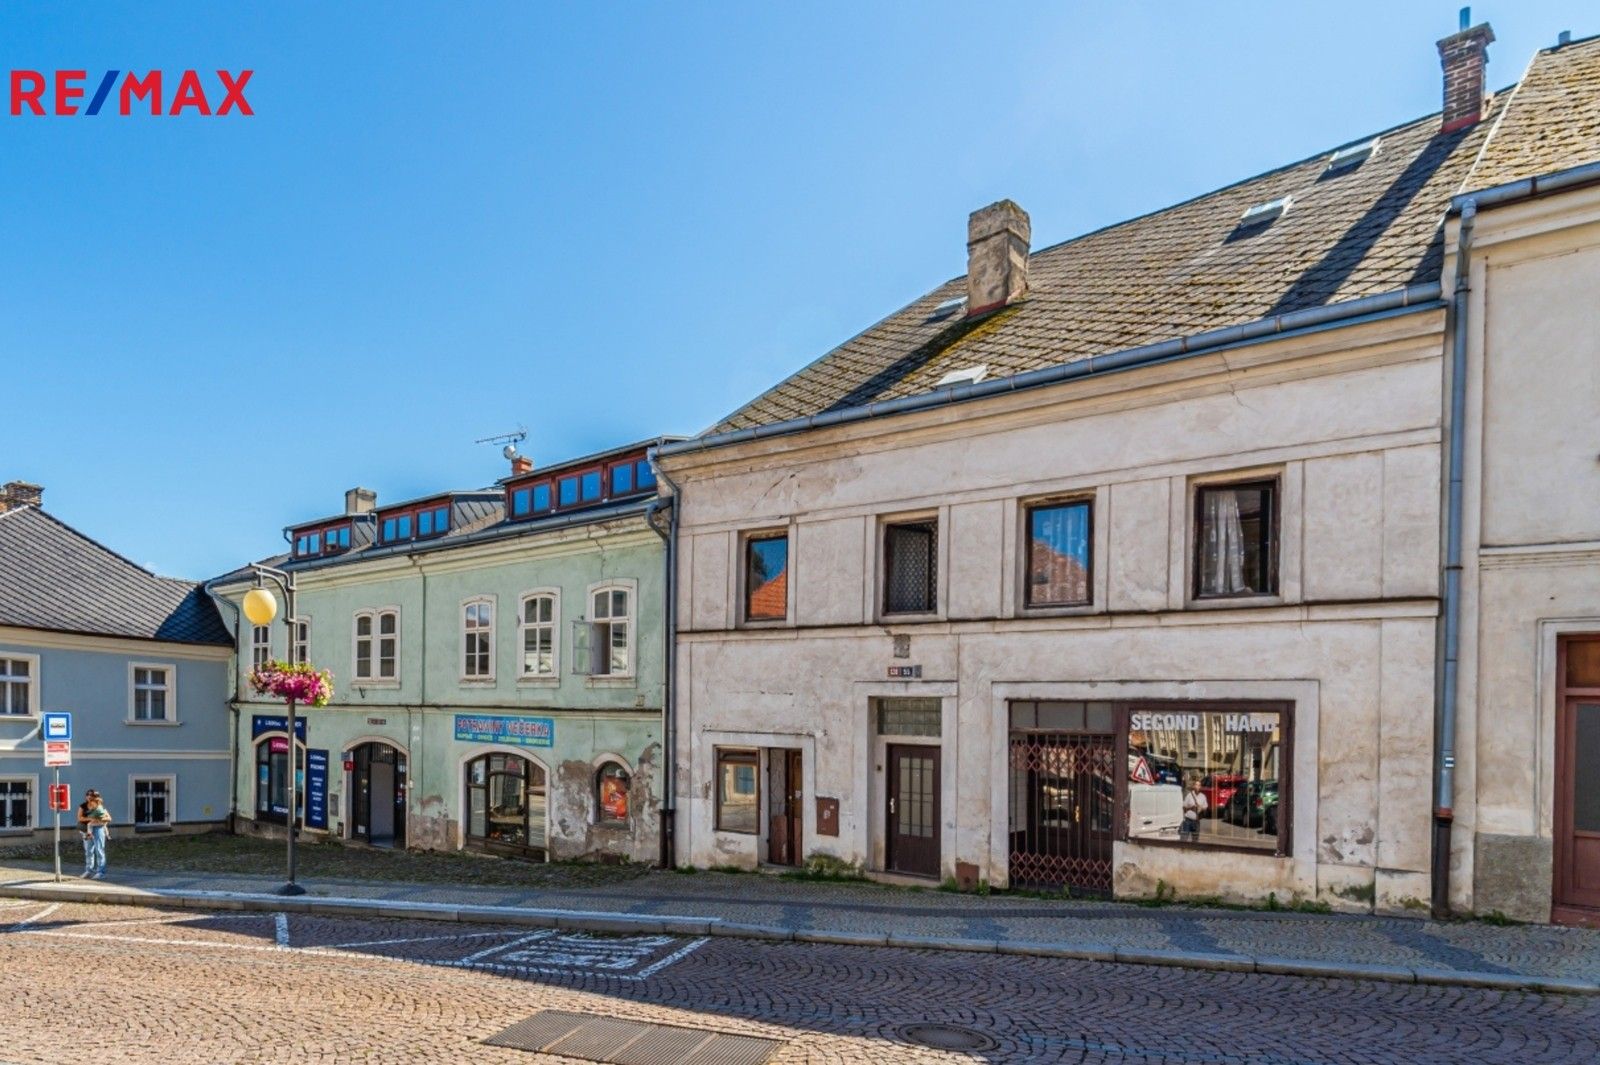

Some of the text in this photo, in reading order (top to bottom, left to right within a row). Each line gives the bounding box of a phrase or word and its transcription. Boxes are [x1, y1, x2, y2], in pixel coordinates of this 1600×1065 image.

[457, 717, 550, 737] POTRAVINY VEČERKA
[1131, 714, 1277, 732] SECOND HAND
